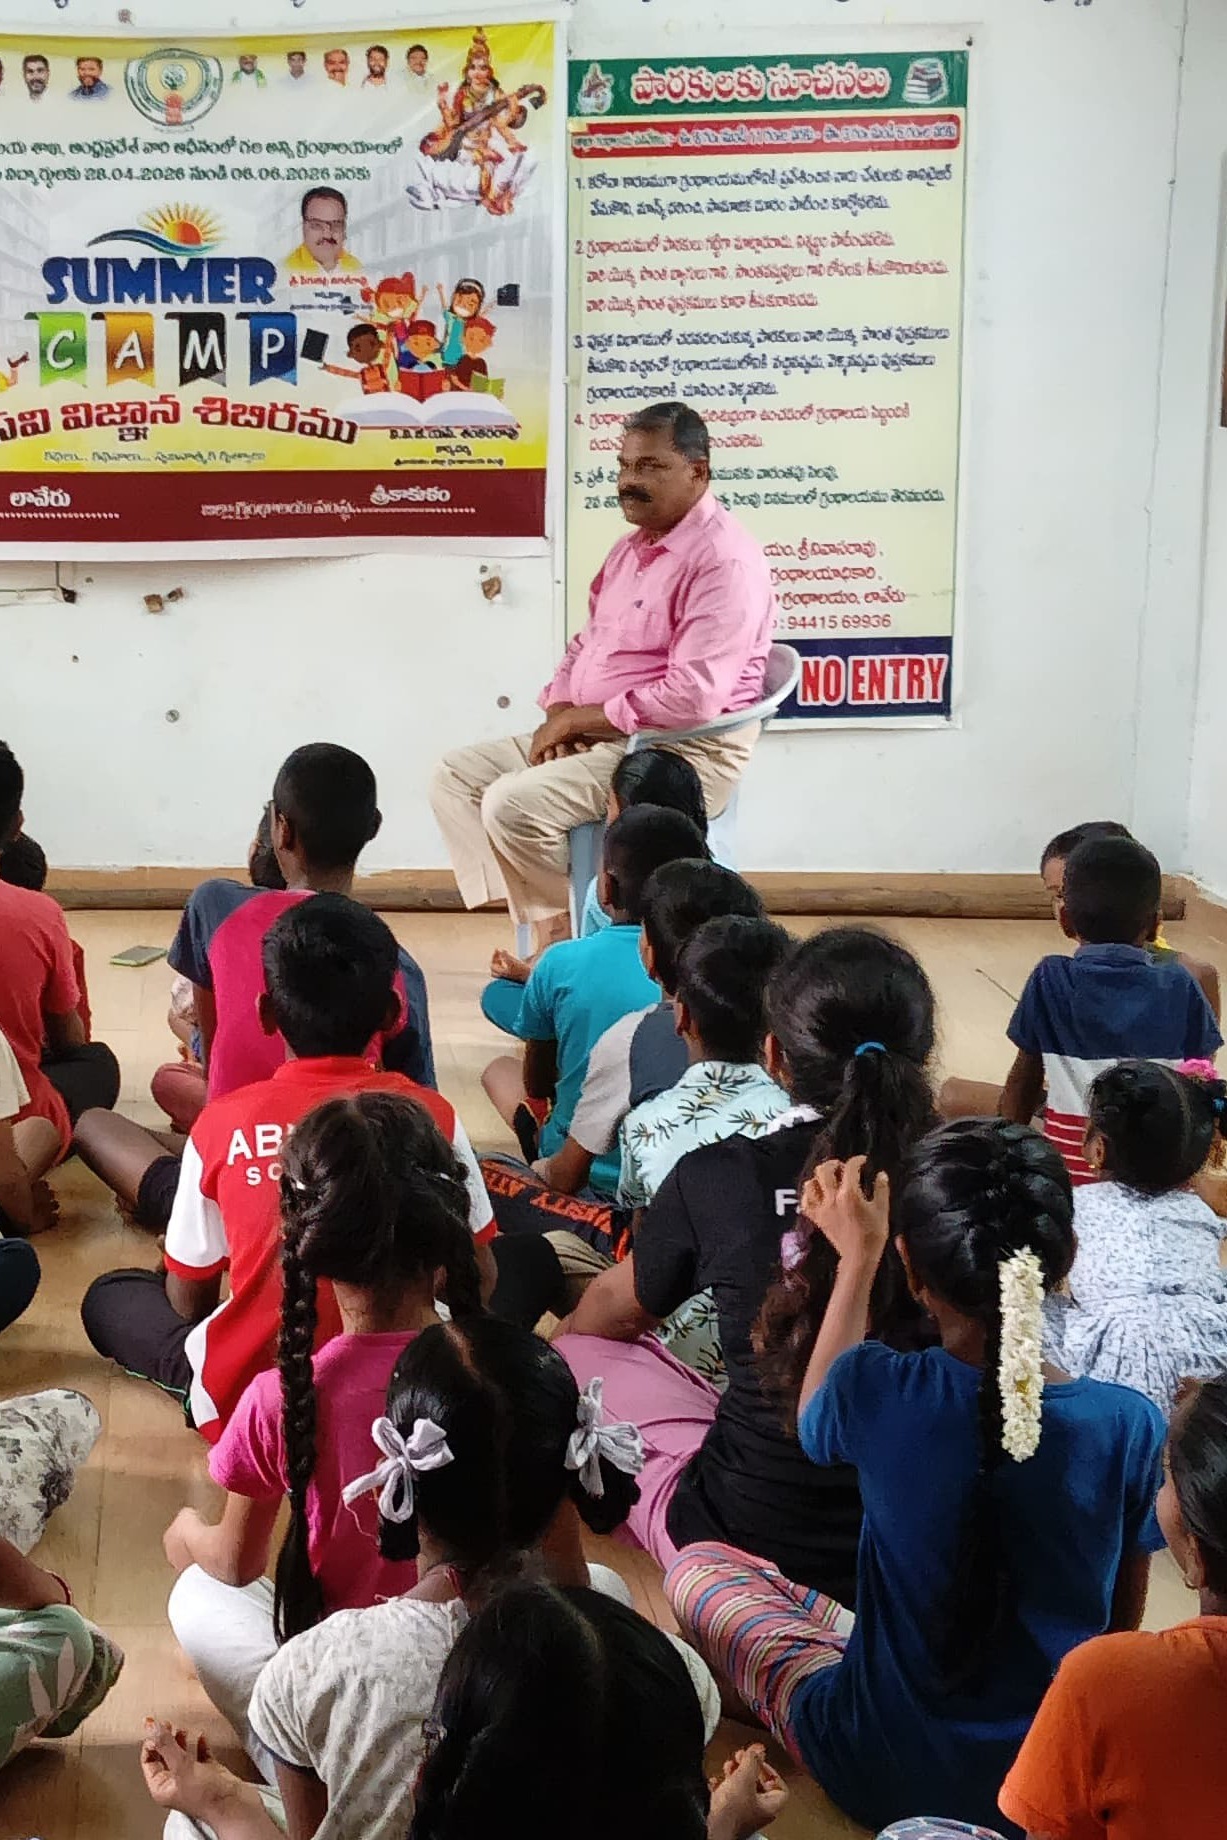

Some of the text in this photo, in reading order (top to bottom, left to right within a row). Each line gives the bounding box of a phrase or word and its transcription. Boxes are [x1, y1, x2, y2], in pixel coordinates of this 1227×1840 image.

[768, 61, 892, 101] సూచనలు
[84, 167, 185, 182] 28.04.2026
[189, 164, 227, 181] నుండి
[231, 167, 330, 182] 06.06.2026
[334, 166, 371, 181] వరకు
[42, 256, 278, 305] SUMMER
[59, 394, 182, 442] విజ్ఞాన
[191, 395, 360, 446] శిబిరము
[9, 485, 72, 508] లావేరు
[787, 615, 838, 631] 94415
[799, 655, 947, 704] NO ENTRY
